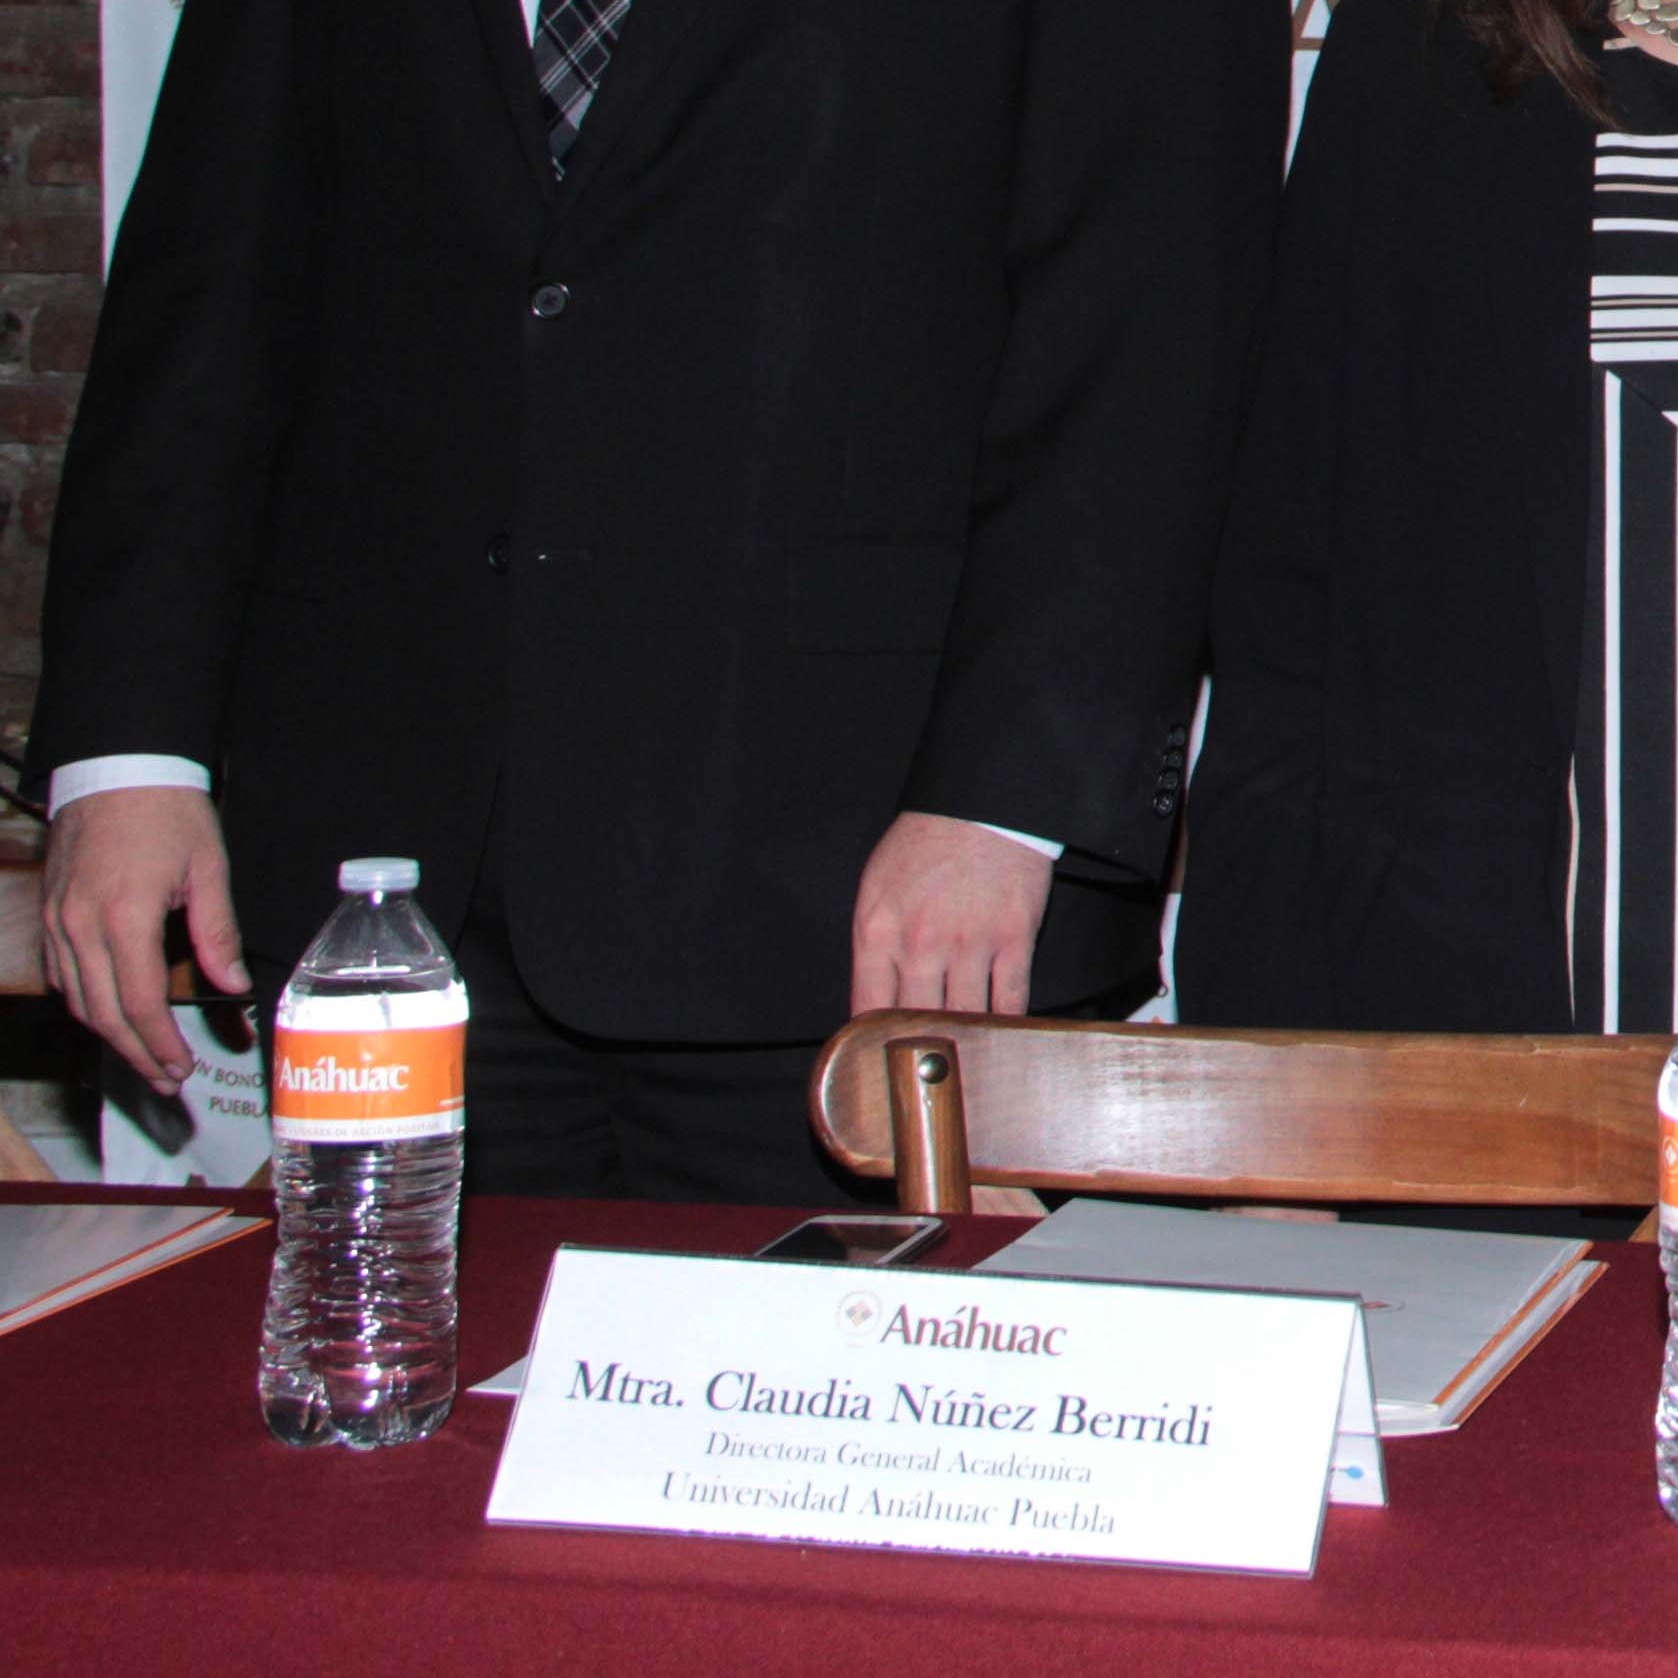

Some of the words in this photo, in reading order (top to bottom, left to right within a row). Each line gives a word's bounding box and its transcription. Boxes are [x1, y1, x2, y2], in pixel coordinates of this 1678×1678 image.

[279, 1056, 410, 1092] Anáhuac
[880, 1303, 1068, 1356] Anáhuac
[566, 1360, 686, 1409] Mtra.
[705, 1370, 872, 1421] Claudia
[888, 1383, 1036, 1432] Núñez
[1050, 1394, 1215, 1446] Berridi
[704, 1431, 828, 1465] Directora
[837, 1442, 941, 1472] General
[947, 1453, 1093, 1485] Académica
[660, 1472, 850, 1515] Universidad
[860, 1488, 1000, 1524] Anáhuac
[1008, 1497, 1116, 1534] Puebla
